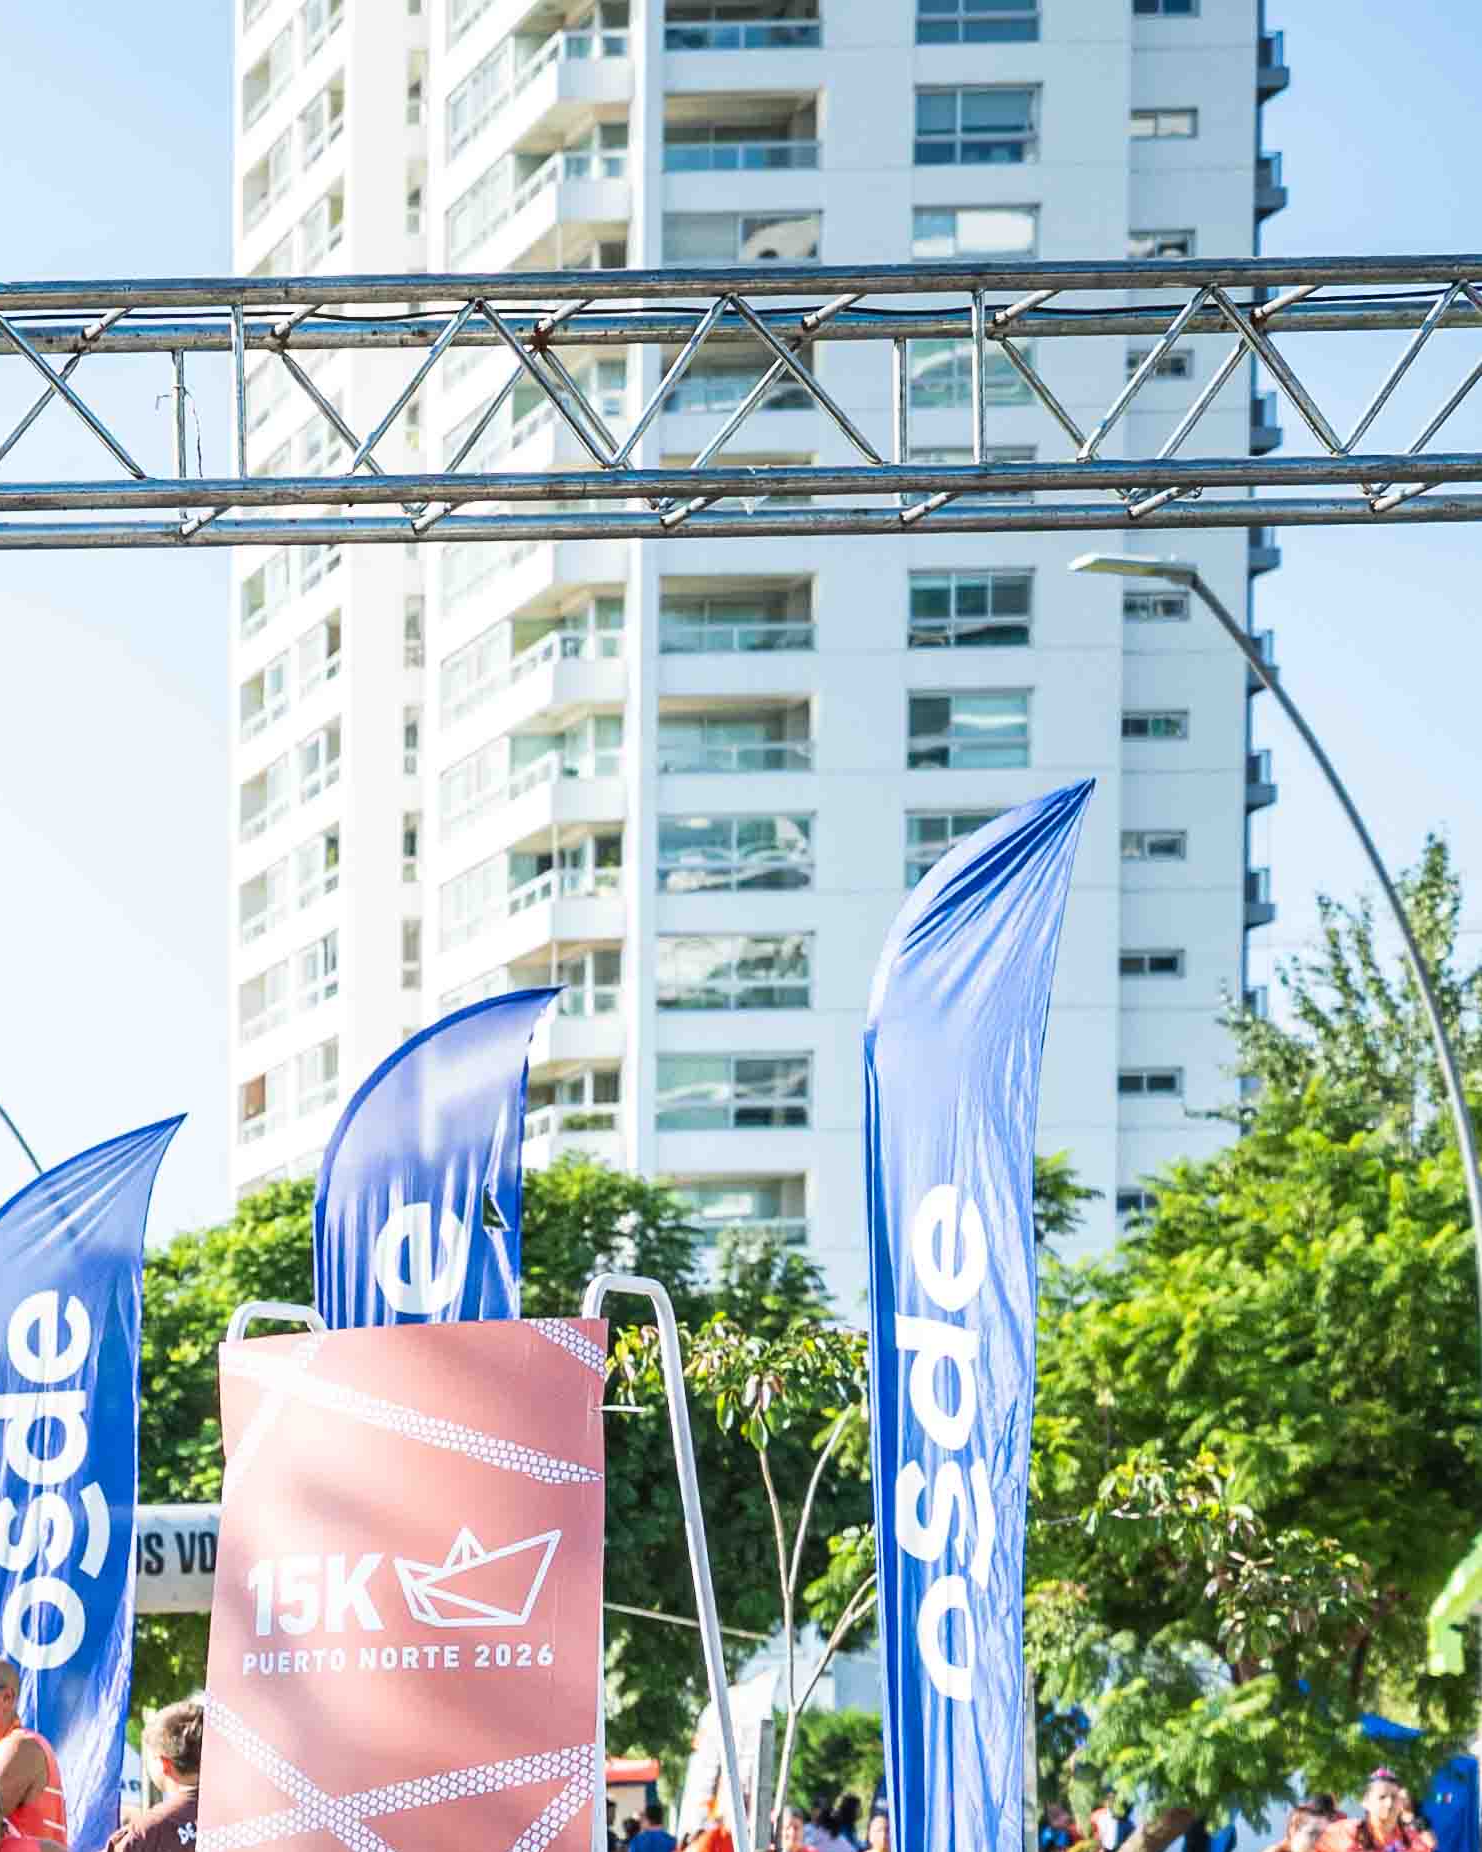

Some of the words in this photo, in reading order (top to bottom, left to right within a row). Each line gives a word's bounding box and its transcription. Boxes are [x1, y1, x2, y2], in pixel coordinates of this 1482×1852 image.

[894, 1183, 998, 1703] osde
[247, 1551, 386, 1637] 15K
[242, 1647, 347, 1676] PUERTO
[358, 1644, 460, 1671] NORTE
[473, 1642, 555, 1669] 2026
